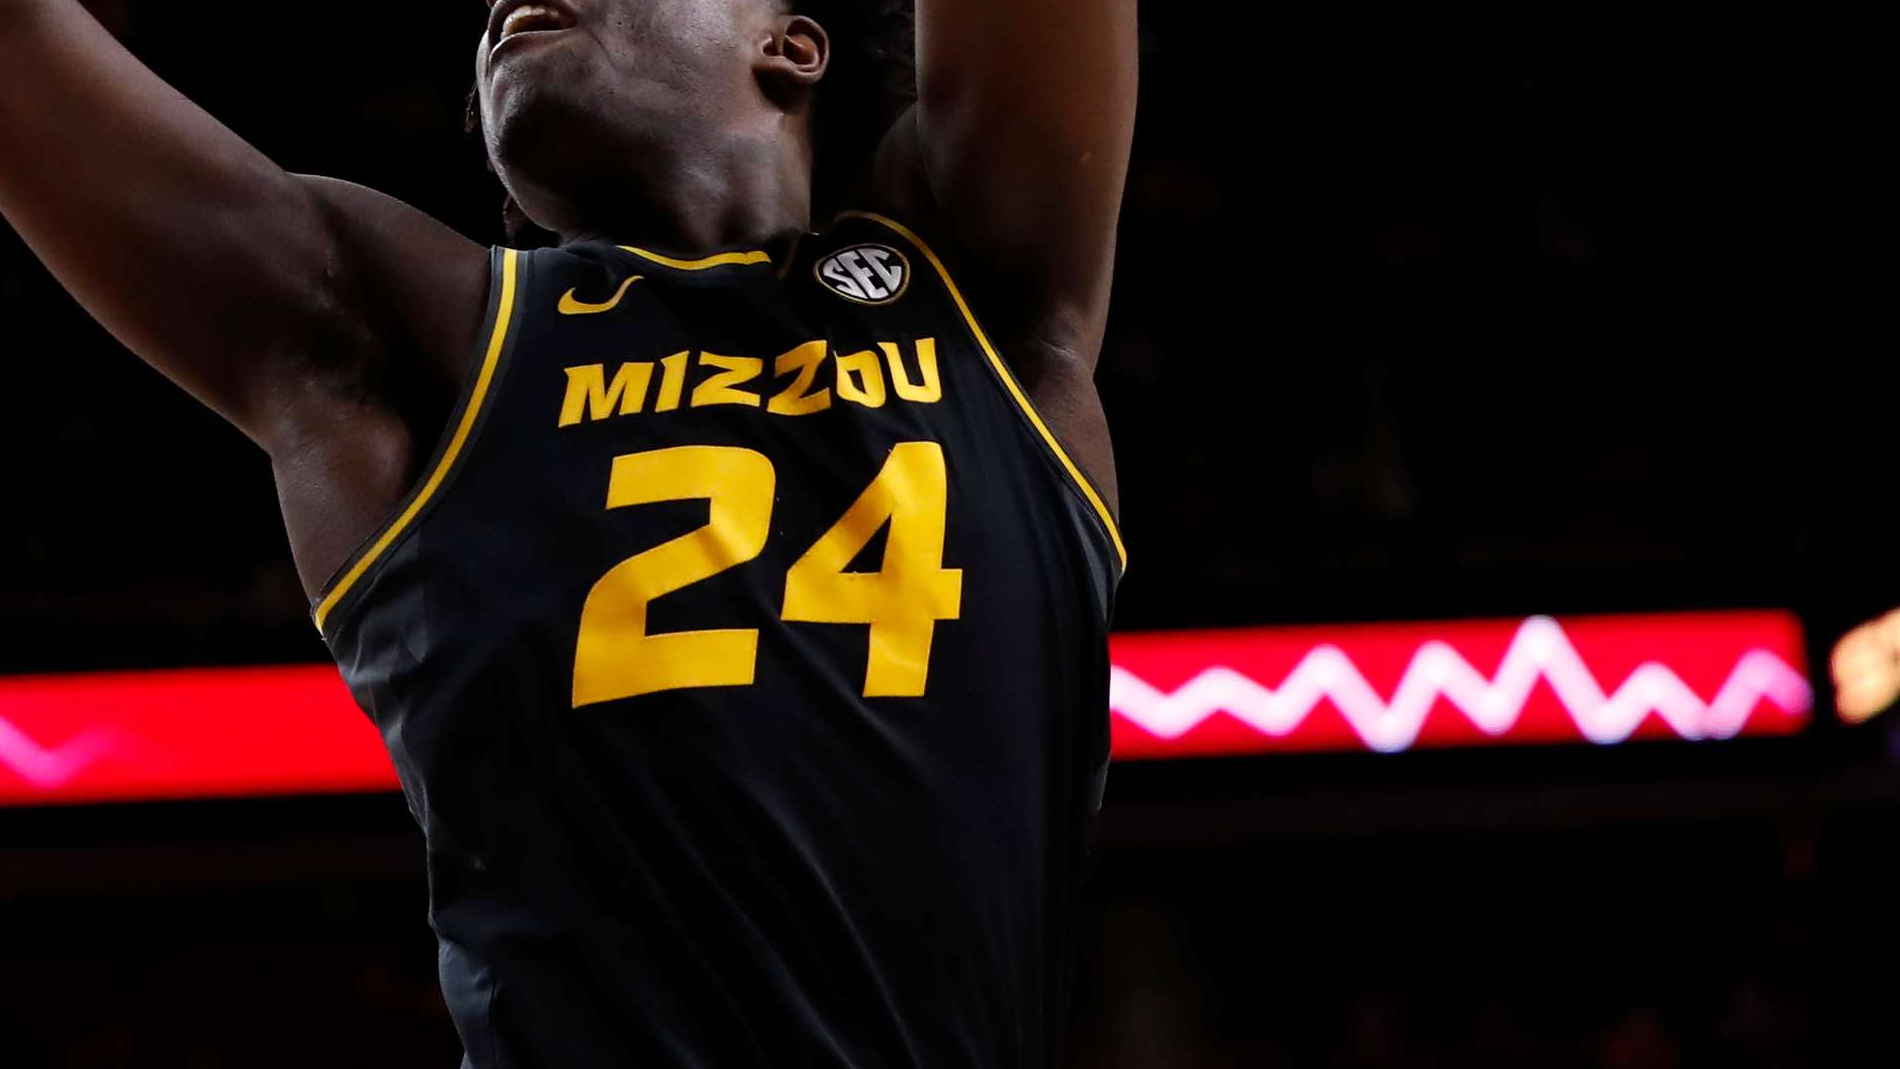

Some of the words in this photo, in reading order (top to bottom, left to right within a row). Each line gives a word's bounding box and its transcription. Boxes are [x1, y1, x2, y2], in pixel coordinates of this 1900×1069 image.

[822, 248, 902, 300] SEC
[557, 337, 943, 428] MIZZOU
[571, 441, 963, 709] 24
